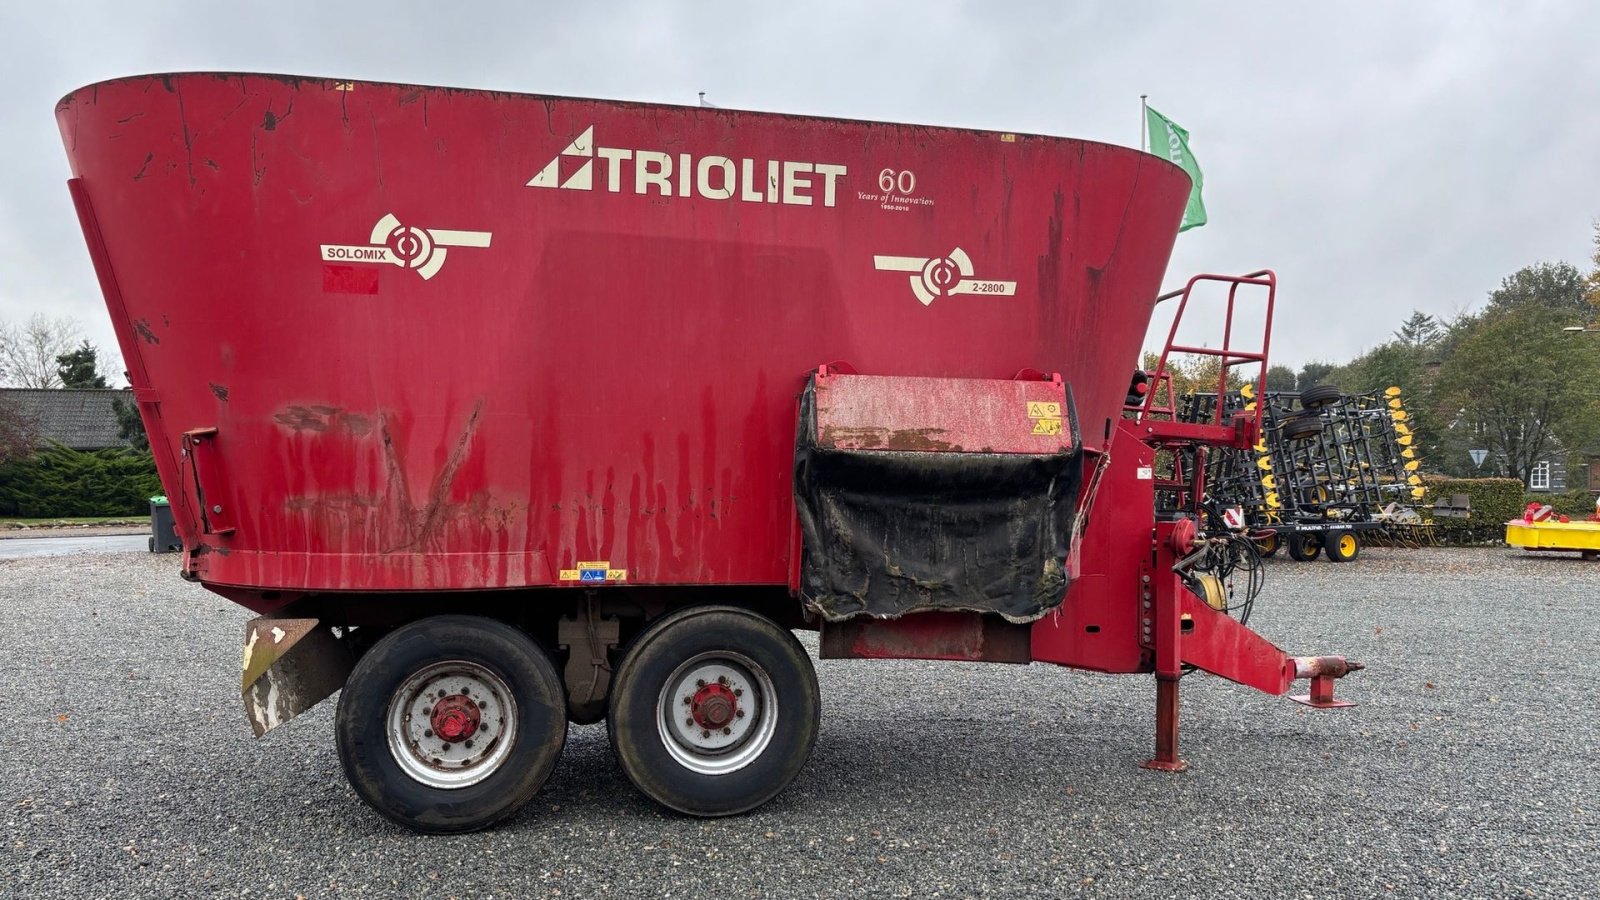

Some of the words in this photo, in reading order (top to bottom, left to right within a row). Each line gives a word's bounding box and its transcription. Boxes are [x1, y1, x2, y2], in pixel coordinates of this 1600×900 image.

[597, 147, 847, 207] TRIOLIET
[879, 168, 916, 194] 60
[857, 191, 878, 200] Years
[881, 192, 890, 203] of
[891, 195, 934, 206] Innovation
[327, 247, 386, 260] SOLOMIX
[972, 282, 1005, 293] 2-2800
